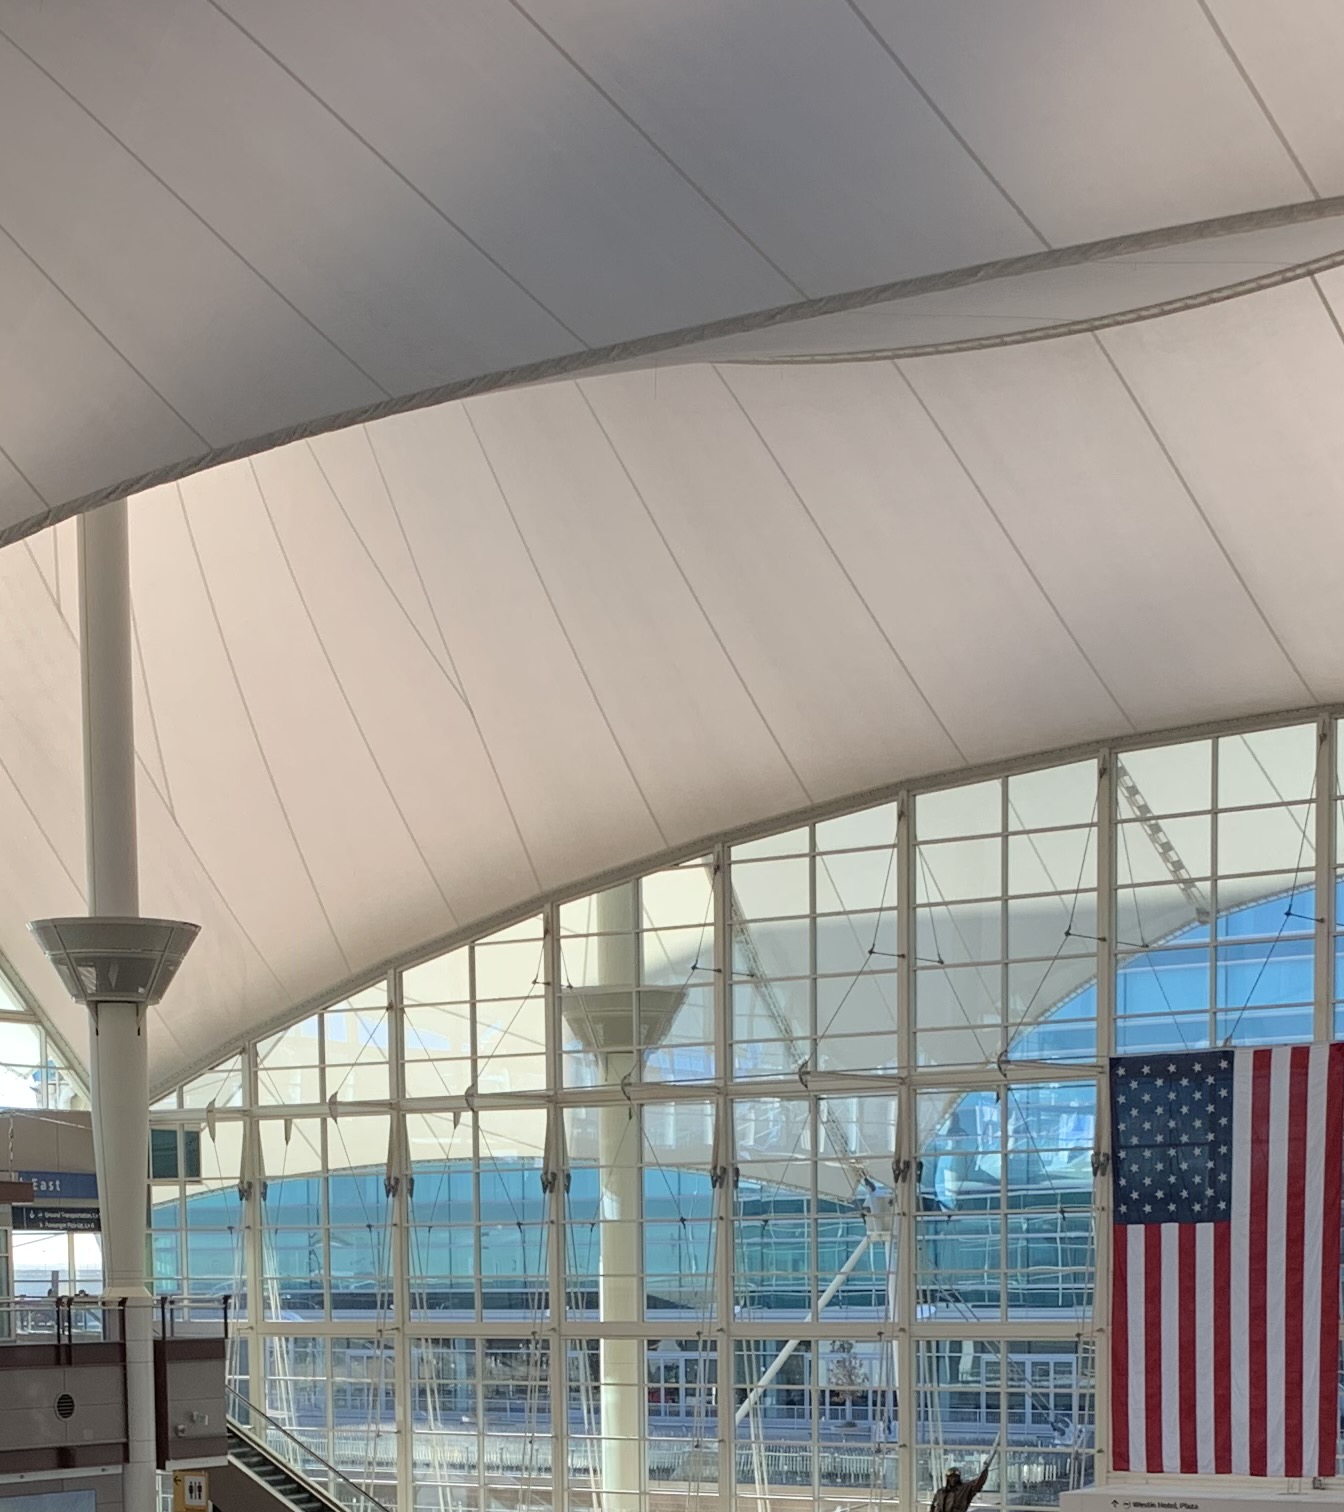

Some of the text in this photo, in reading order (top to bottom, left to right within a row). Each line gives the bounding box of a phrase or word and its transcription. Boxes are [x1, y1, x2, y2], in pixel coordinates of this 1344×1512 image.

[32, 1178, 61, 1191] East
[1132, 1501, 1156, 1509] Westin
[1179, 1502, 1199, 1510] Plaza
